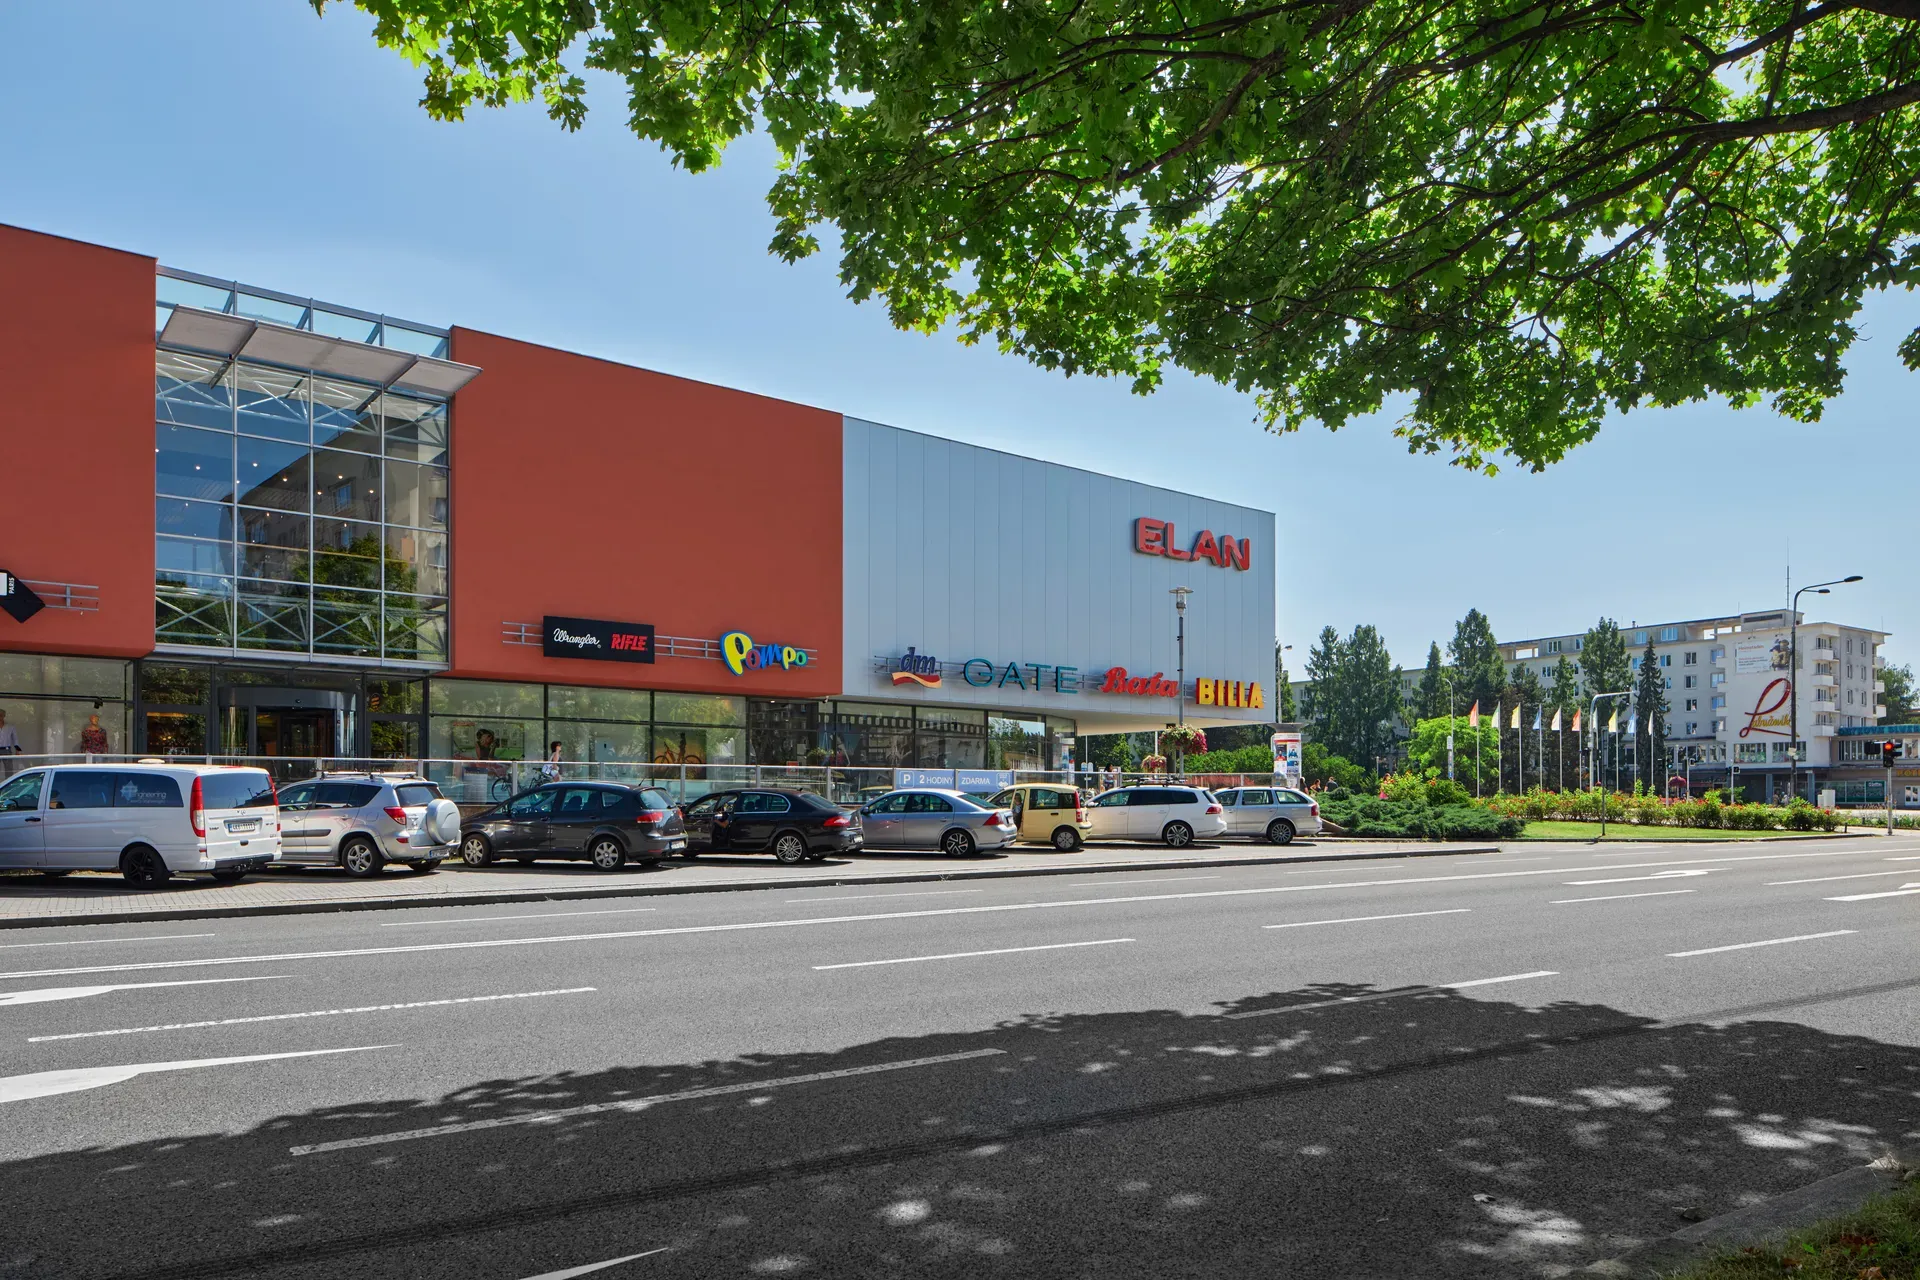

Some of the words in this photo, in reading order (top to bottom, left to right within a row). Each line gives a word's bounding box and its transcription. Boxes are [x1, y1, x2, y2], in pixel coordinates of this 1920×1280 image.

[1135, 517, 1250, 571] ELAN
[553, 628, 599, 648] Wrangler
[611, 633, 648, 651] RIFLE
[720, 630, 808, 676] Pompo
[900, 647, 936, 674] dm
[963, 658, 1078, 694] GATE
[1196, 677, 1265, 709] BILLA
[903, 774, 911, 784] P
[919, 775, 925, 784] 2
